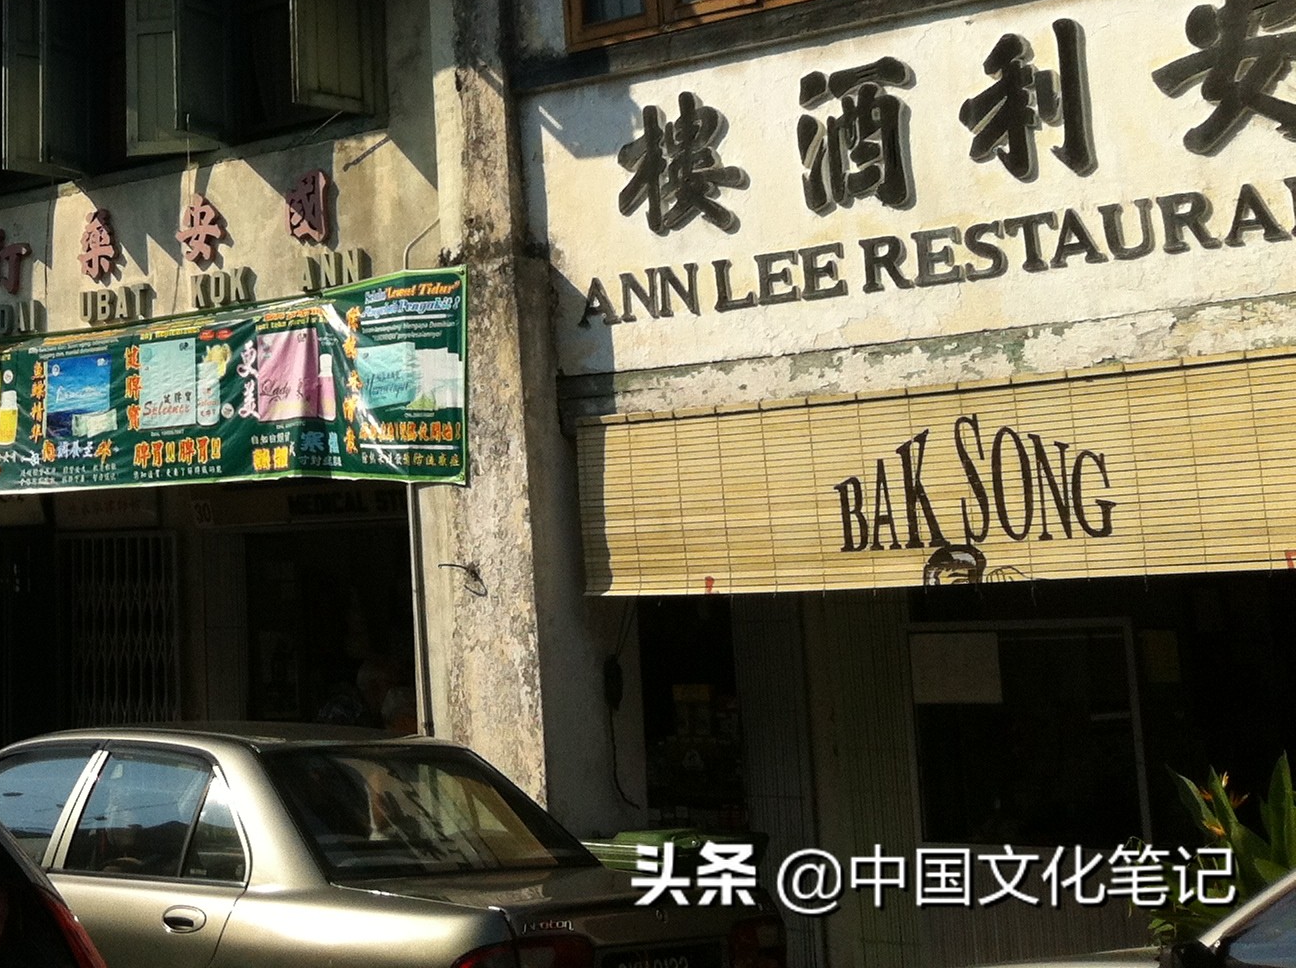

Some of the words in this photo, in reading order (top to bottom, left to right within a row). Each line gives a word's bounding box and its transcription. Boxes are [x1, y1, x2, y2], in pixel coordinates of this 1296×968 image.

[79, 282, 156, 326] UBAT
[191, 266, 256, 310] KOK
[302, 248, 371, 293] ANN
[577, 261, 701, 330] ANN
[710, 241, 849, 313] LEE
[857, 176, 1296, 295] RESTAURA
[835, 428, 949, 552] BAK
[955, 413, 1116, 546] SONG
